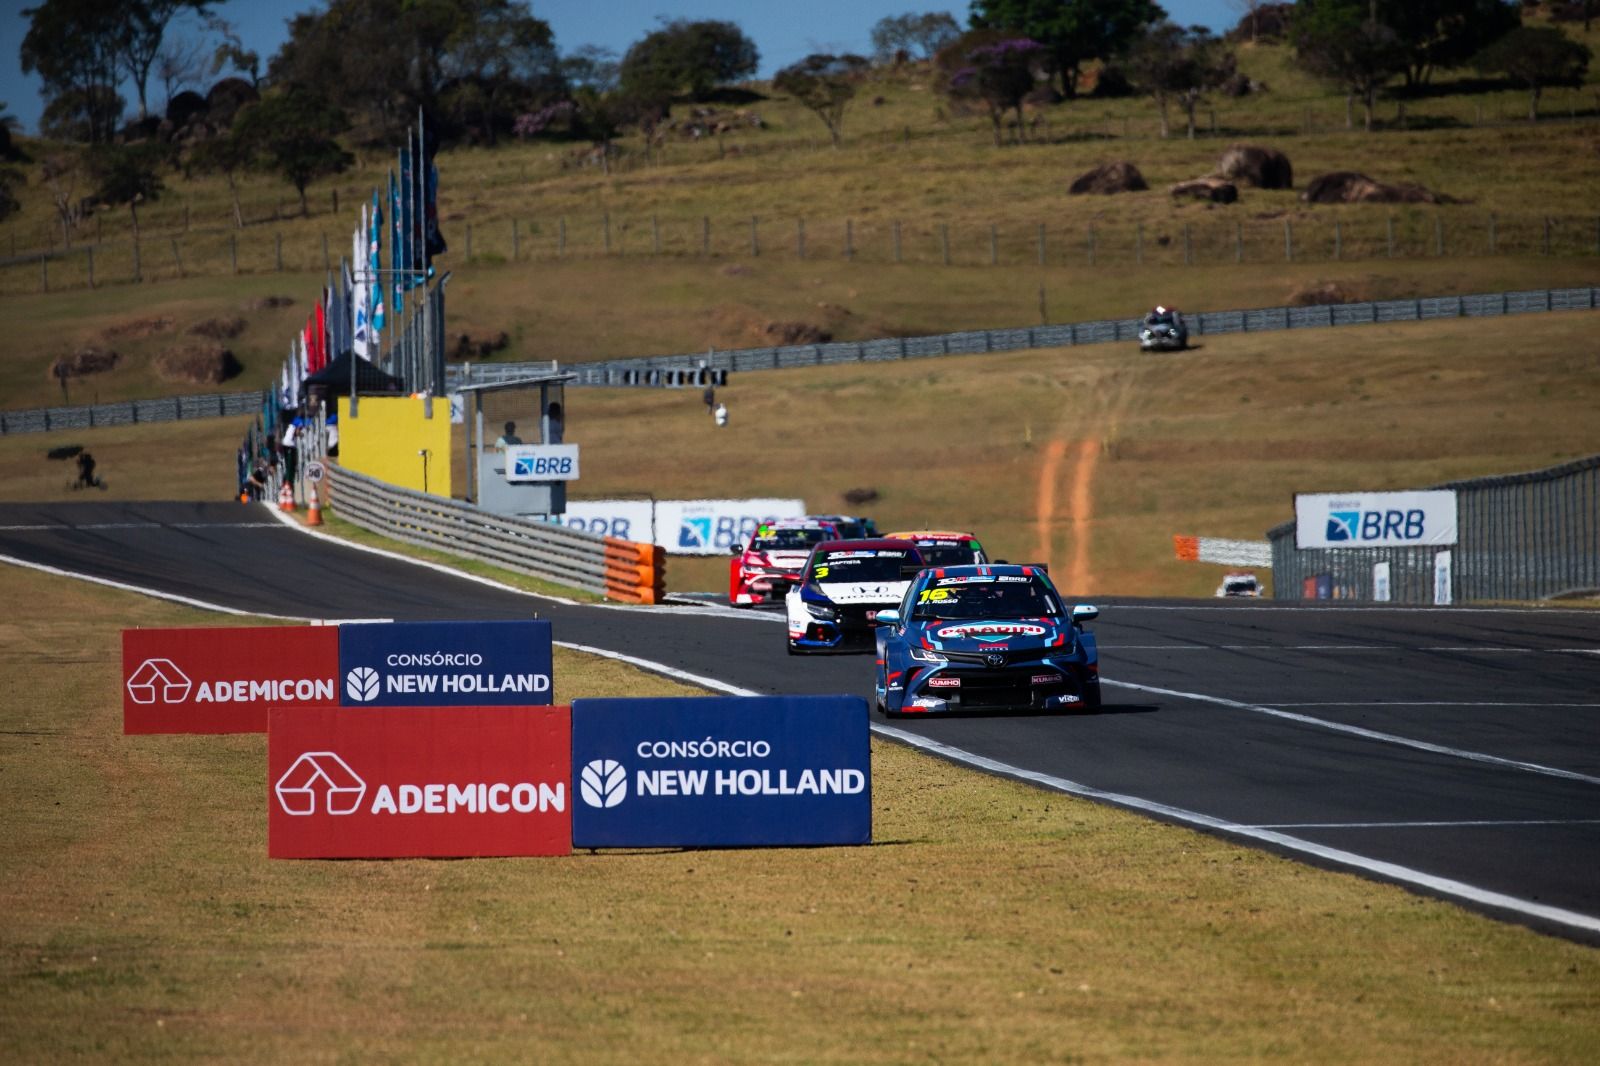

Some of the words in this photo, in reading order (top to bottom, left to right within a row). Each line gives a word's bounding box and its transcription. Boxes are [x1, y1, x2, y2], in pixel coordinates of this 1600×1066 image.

[534, 456, 572, 474] BRB
[1361, 509, 1425, 540] BRB
[814, 567, 830, 579] 3
[919, 588, 949, 602] 16
[942, 626, 1041, 635] PALADINI
[387, 650, 483, 667] CONSÓRCIO
[195, 678, 334, 703] ADEMICON
[386, 674, 440, 693] NEW
[442, 673, 550, 693] HOLLAND
[930, 678, 960, 687] KUMHO
[636, 736, 771, 759] CONSÓRCIO
[636, 770, 709, 796] NEW
[714, 768, 866, 796] HOLLAND
[371, 782, 565, 815] ADEMICON
